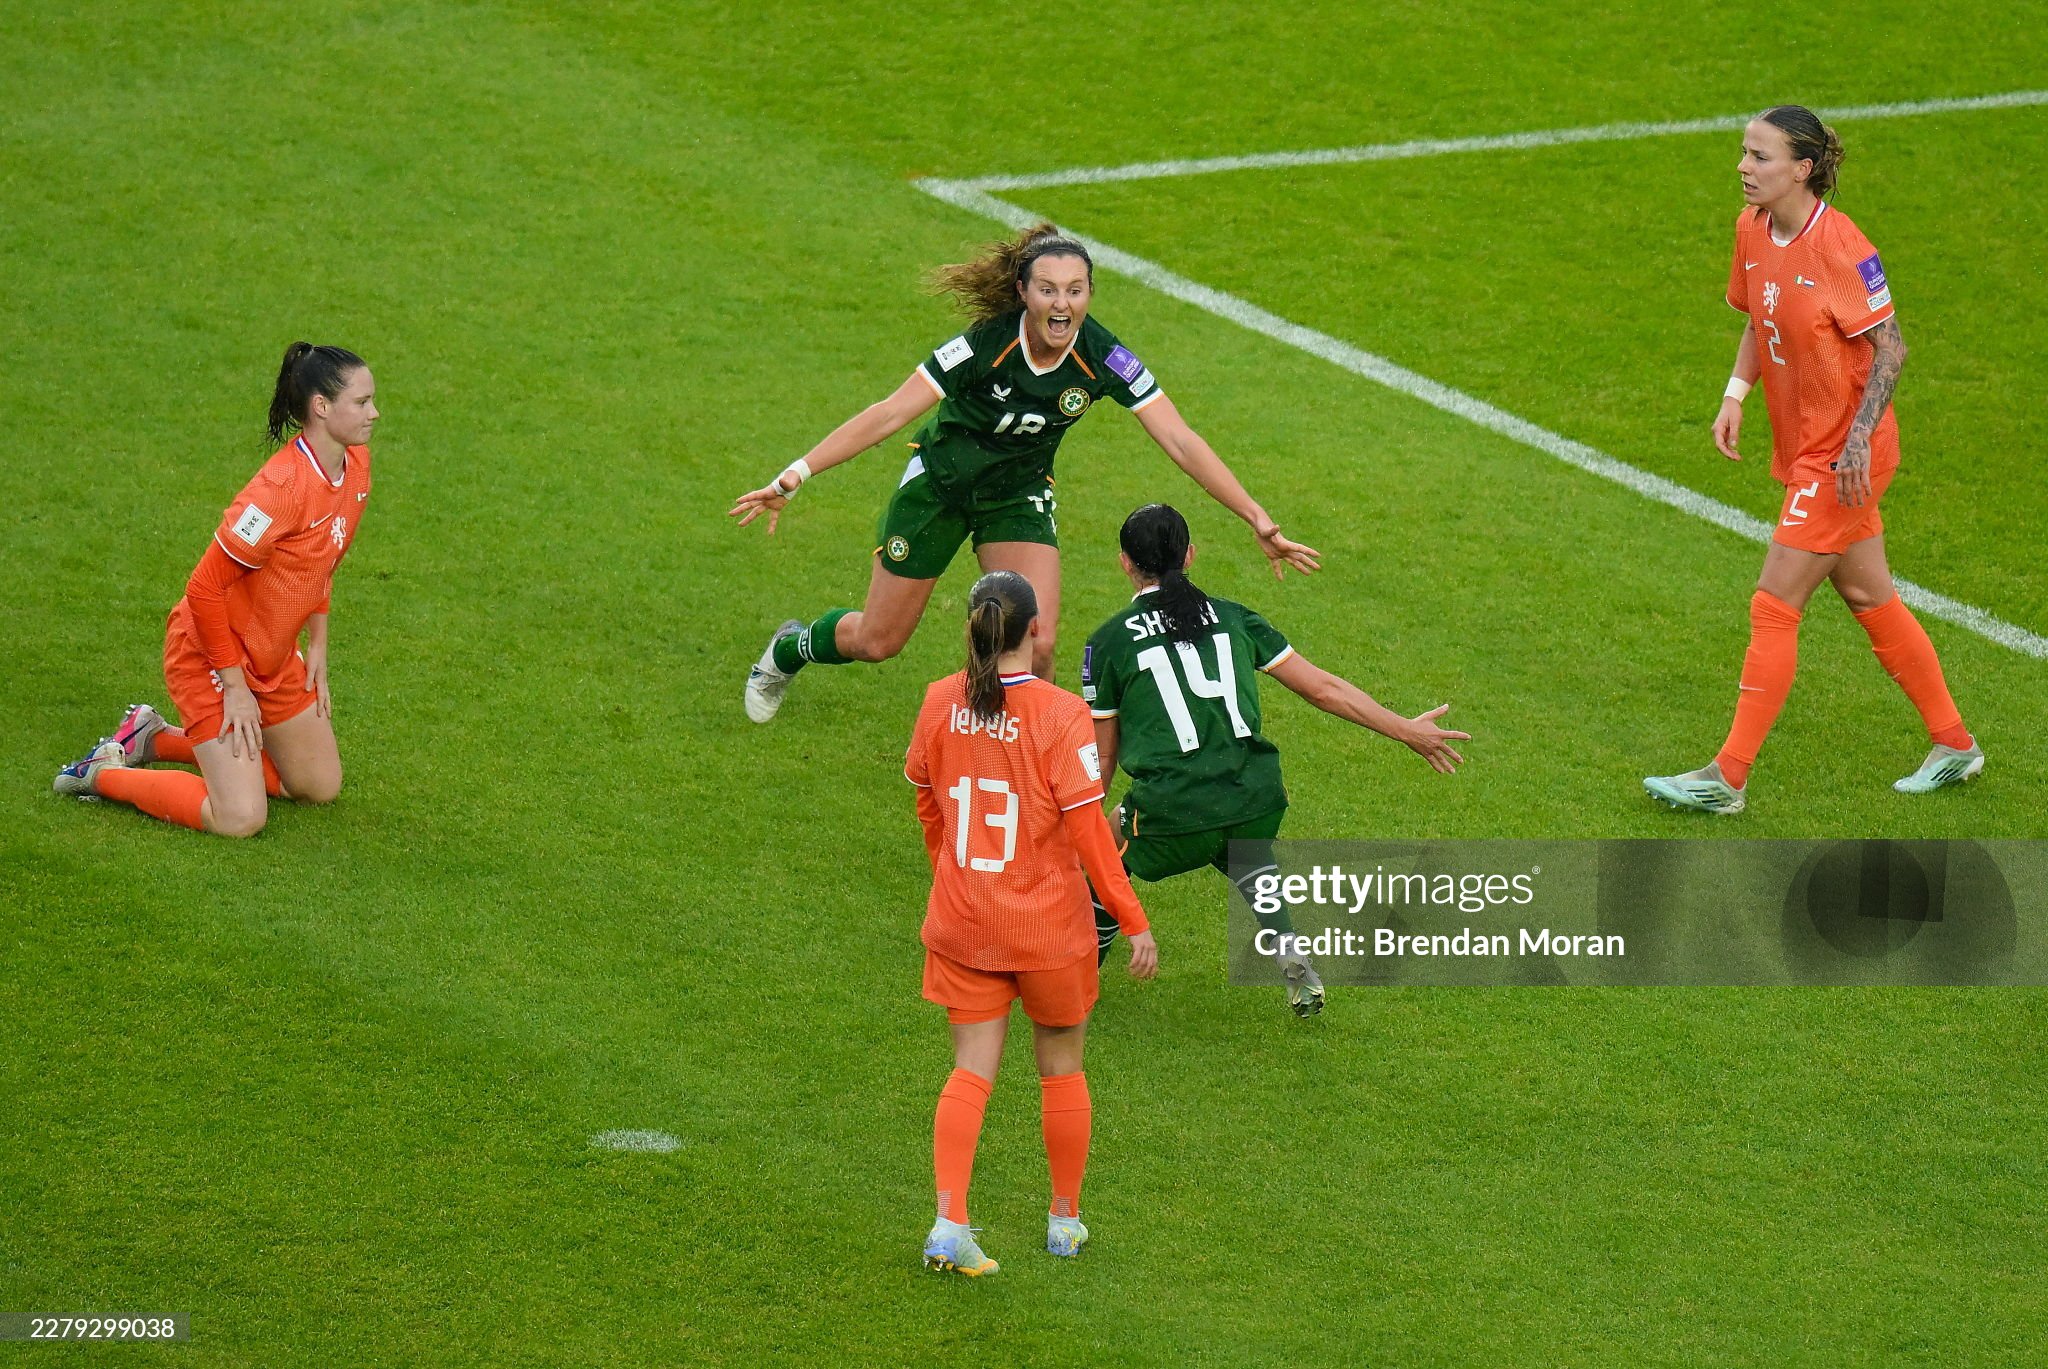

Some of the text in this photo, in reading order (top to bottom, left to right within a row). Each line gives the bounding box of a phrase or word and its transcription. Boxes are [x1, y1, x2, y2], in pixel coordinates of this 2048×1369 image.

[1763, 319, 1786, 366] 2
[1789, 481, 1819, 519] 2
[1136, 632, 1252, 753] 14
[949, 776, 1019, 872] 13
